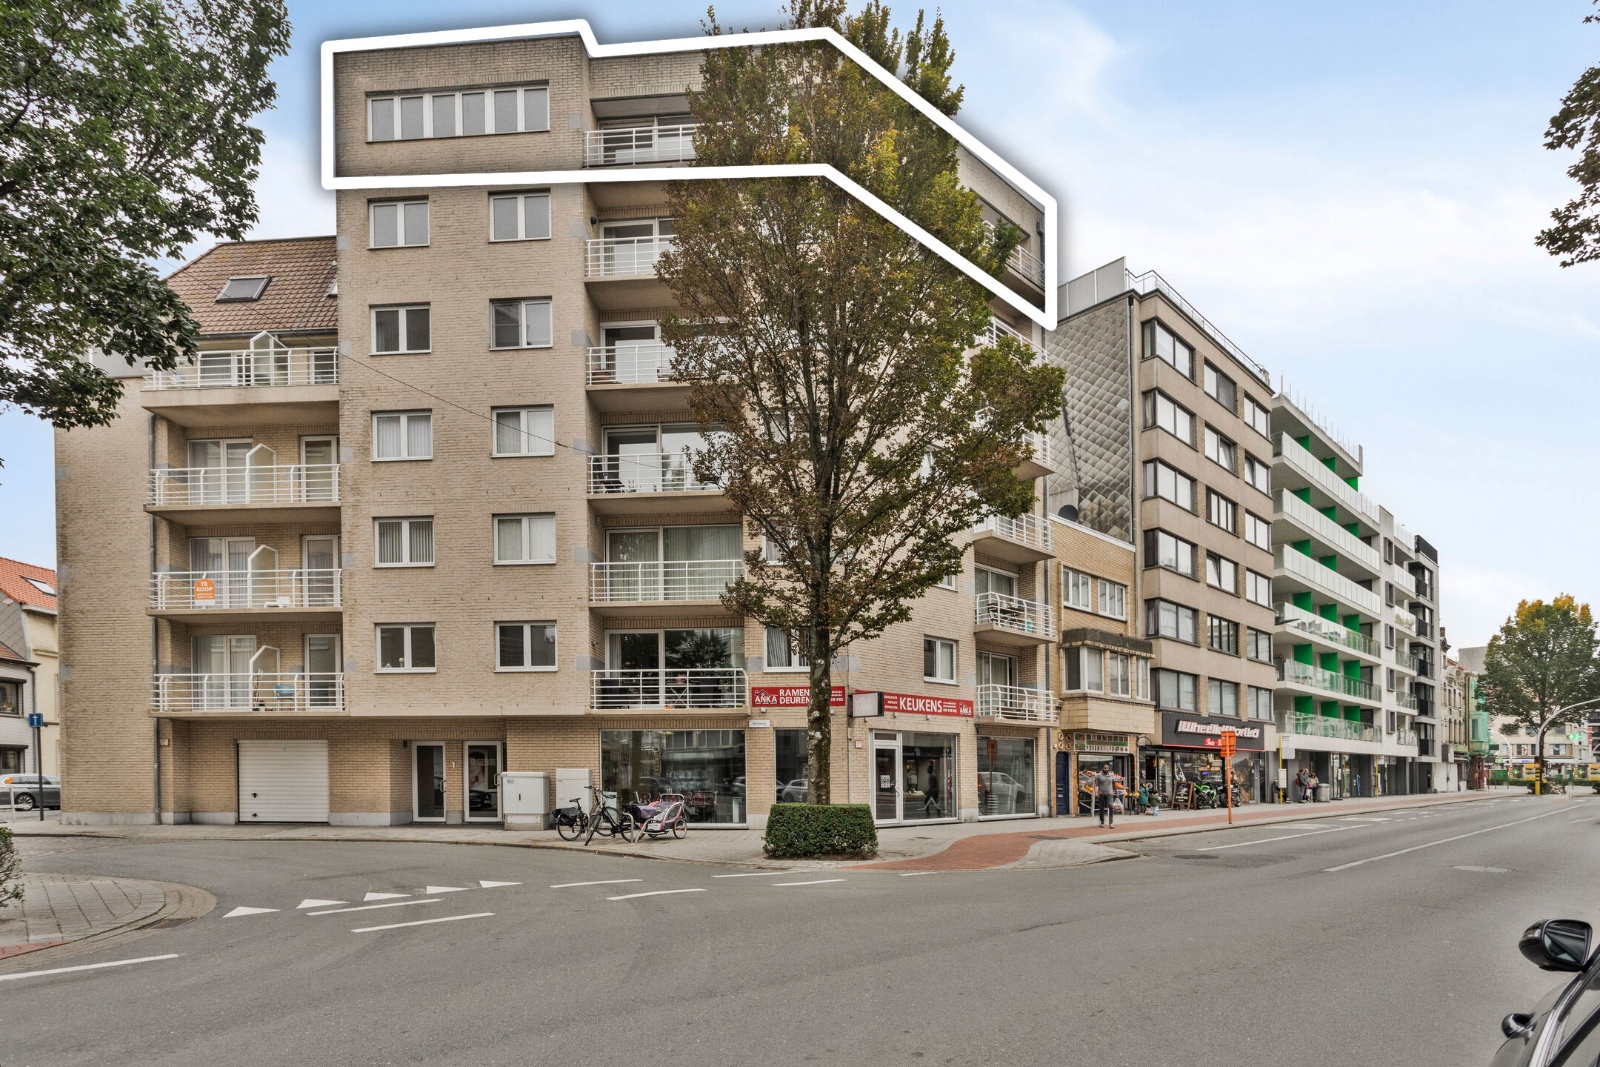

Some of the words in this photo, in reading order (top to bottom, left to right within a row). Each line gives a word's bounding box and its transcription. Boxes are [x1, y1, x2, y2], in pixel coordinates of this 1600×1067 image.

[779, 688, 810, 697] RAMEN
[754, 695, 778, 703] ANKA
[779, 696, 811, 704] DEUREN
[899, 696, 942, 713] KEUKENS
